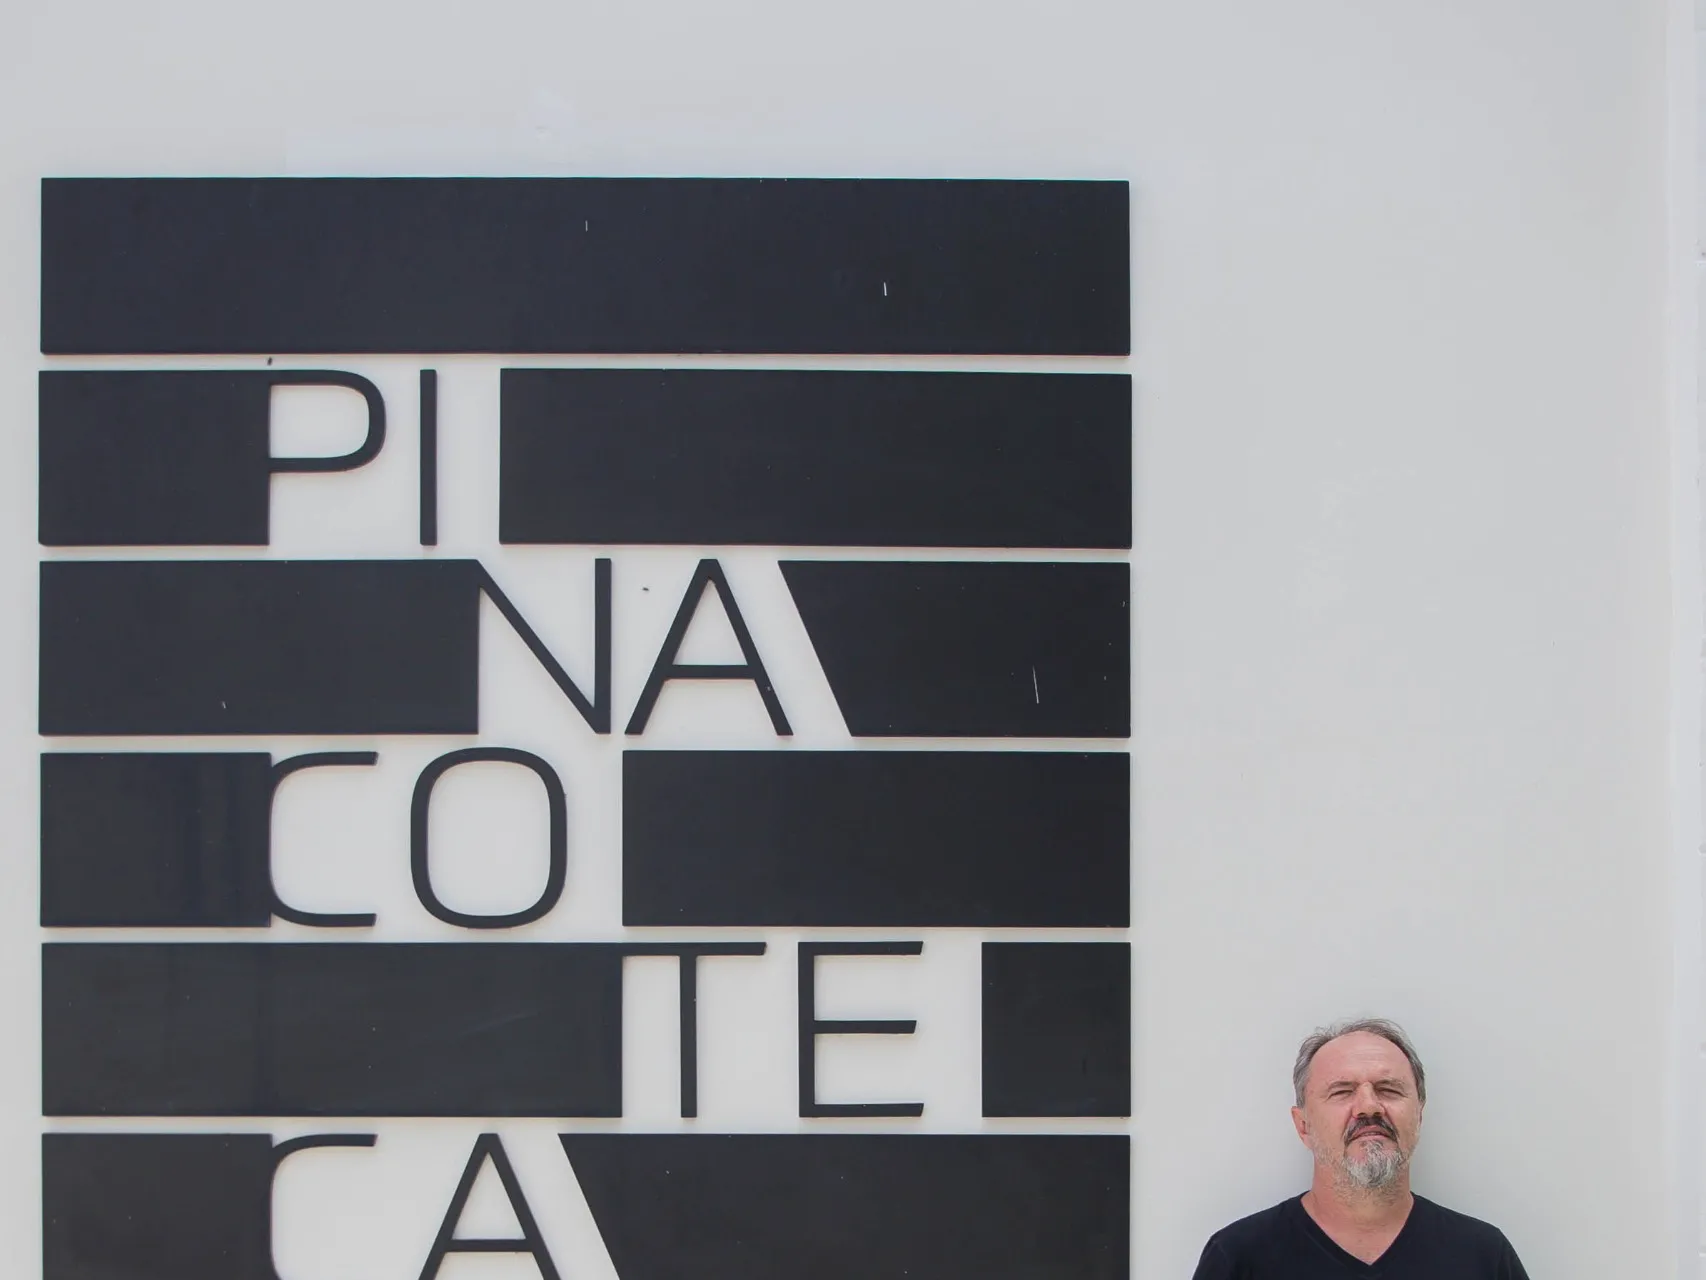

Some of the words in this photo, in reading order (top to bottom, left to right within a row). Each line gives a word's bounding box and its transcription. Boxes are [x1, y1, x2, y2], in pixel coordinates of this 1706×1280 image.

[253, 369, 438, 546] PI
[463, 558, 794, 736] NA
[254, 746, 568, 930] CO
[611, 941, 924, 1118] TE
